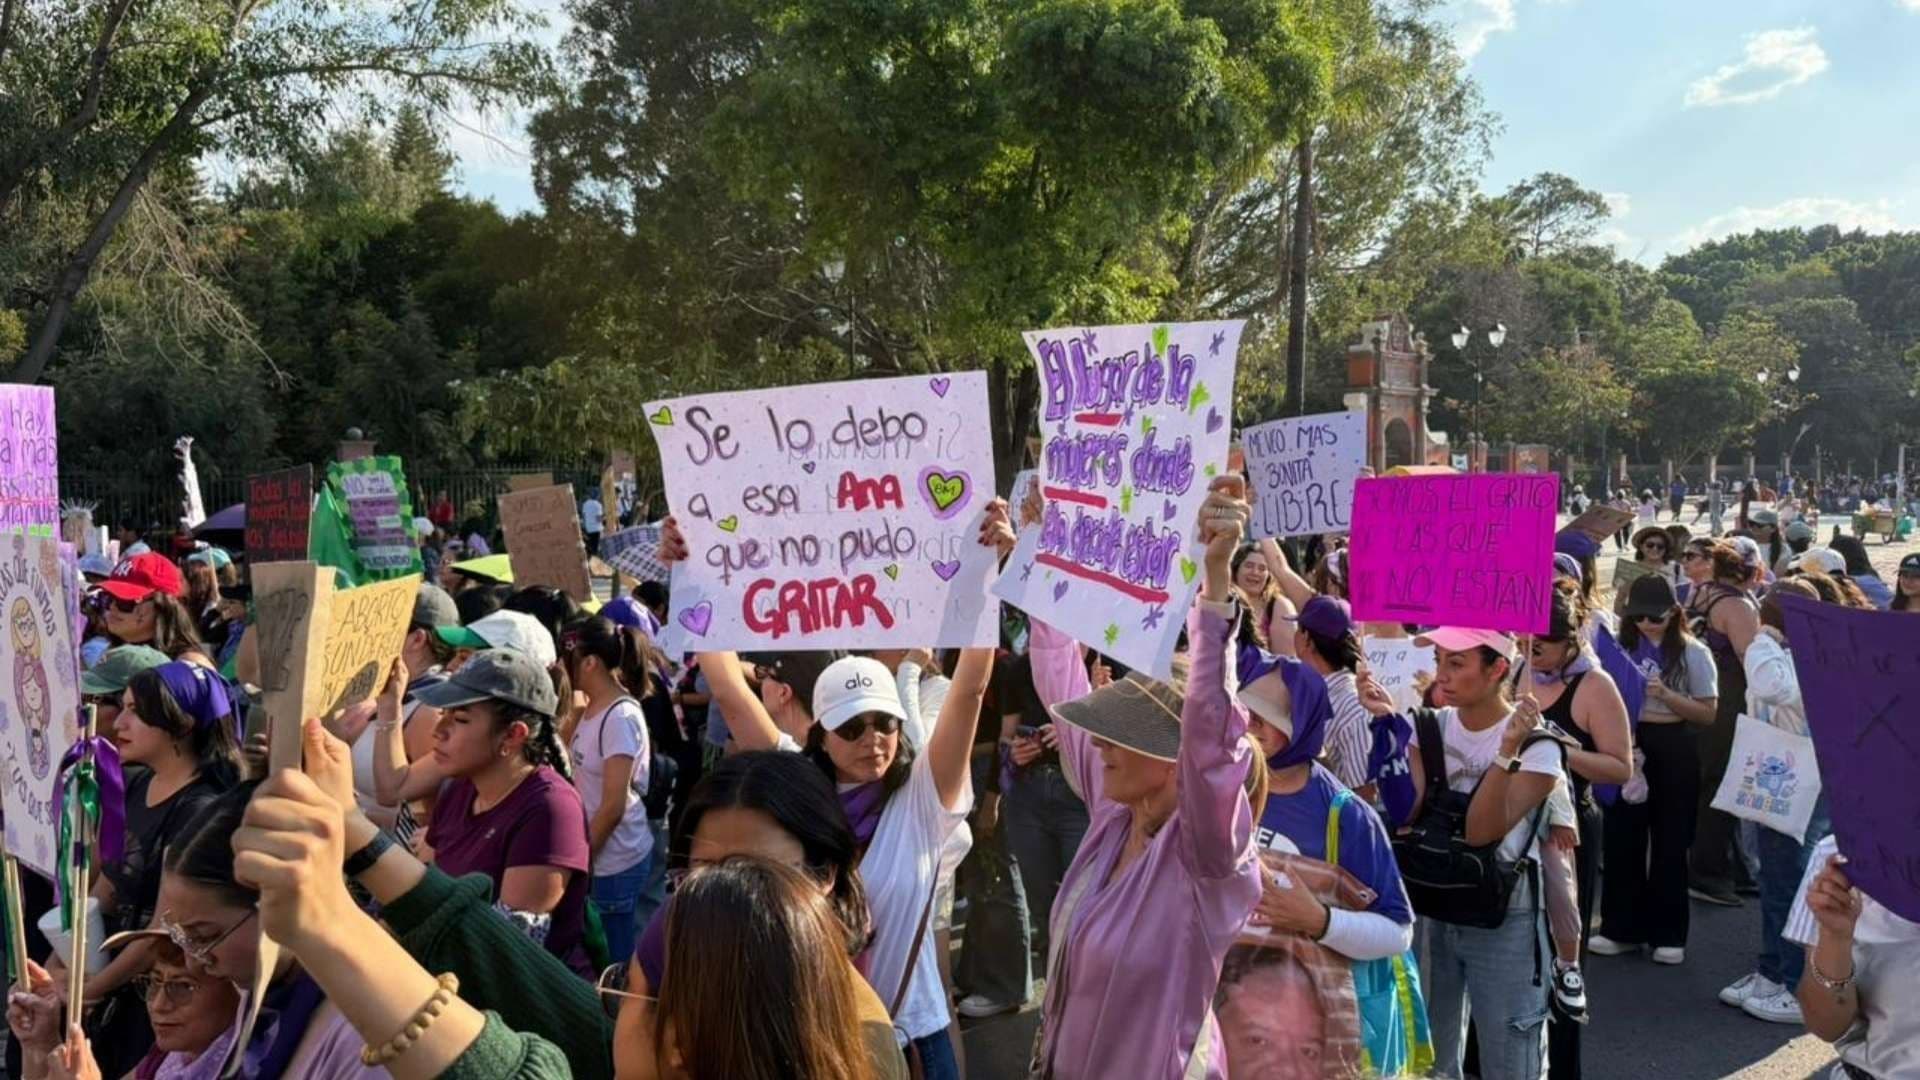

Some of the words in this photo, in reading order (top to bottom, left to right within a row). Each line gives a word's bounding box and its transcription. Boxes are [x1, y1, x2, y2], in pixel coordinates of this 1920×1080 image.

[1069, 338, 1139, 414] lugar
[1132, 342, 1165, 409] de
[10, 399, 47, 436] hay
[685, 406, 740, 466] Se
[766, 406, 813, 451] lo
[832, 405, 927, 449] debo
[1297, 424, 1338, 448] MAS
[688, 493, 712, 521] a
[743, 484, 799, 516] esa
[837, 471, 904, 510] Ana
[1449, 477, 1478, 511] EL
[1487, 477, 1556, 509] GRITO
[705, 537, 769, 587] que
[780, 534, 821, 566] no
[839, 519, 916, 574] pudo
[1446, 521, 1505, 554] QUE
[1389, 566, 1433, 603] NO
[743, 574, 894, 639] GRITAR
[845, 672, 873, 690] alo
